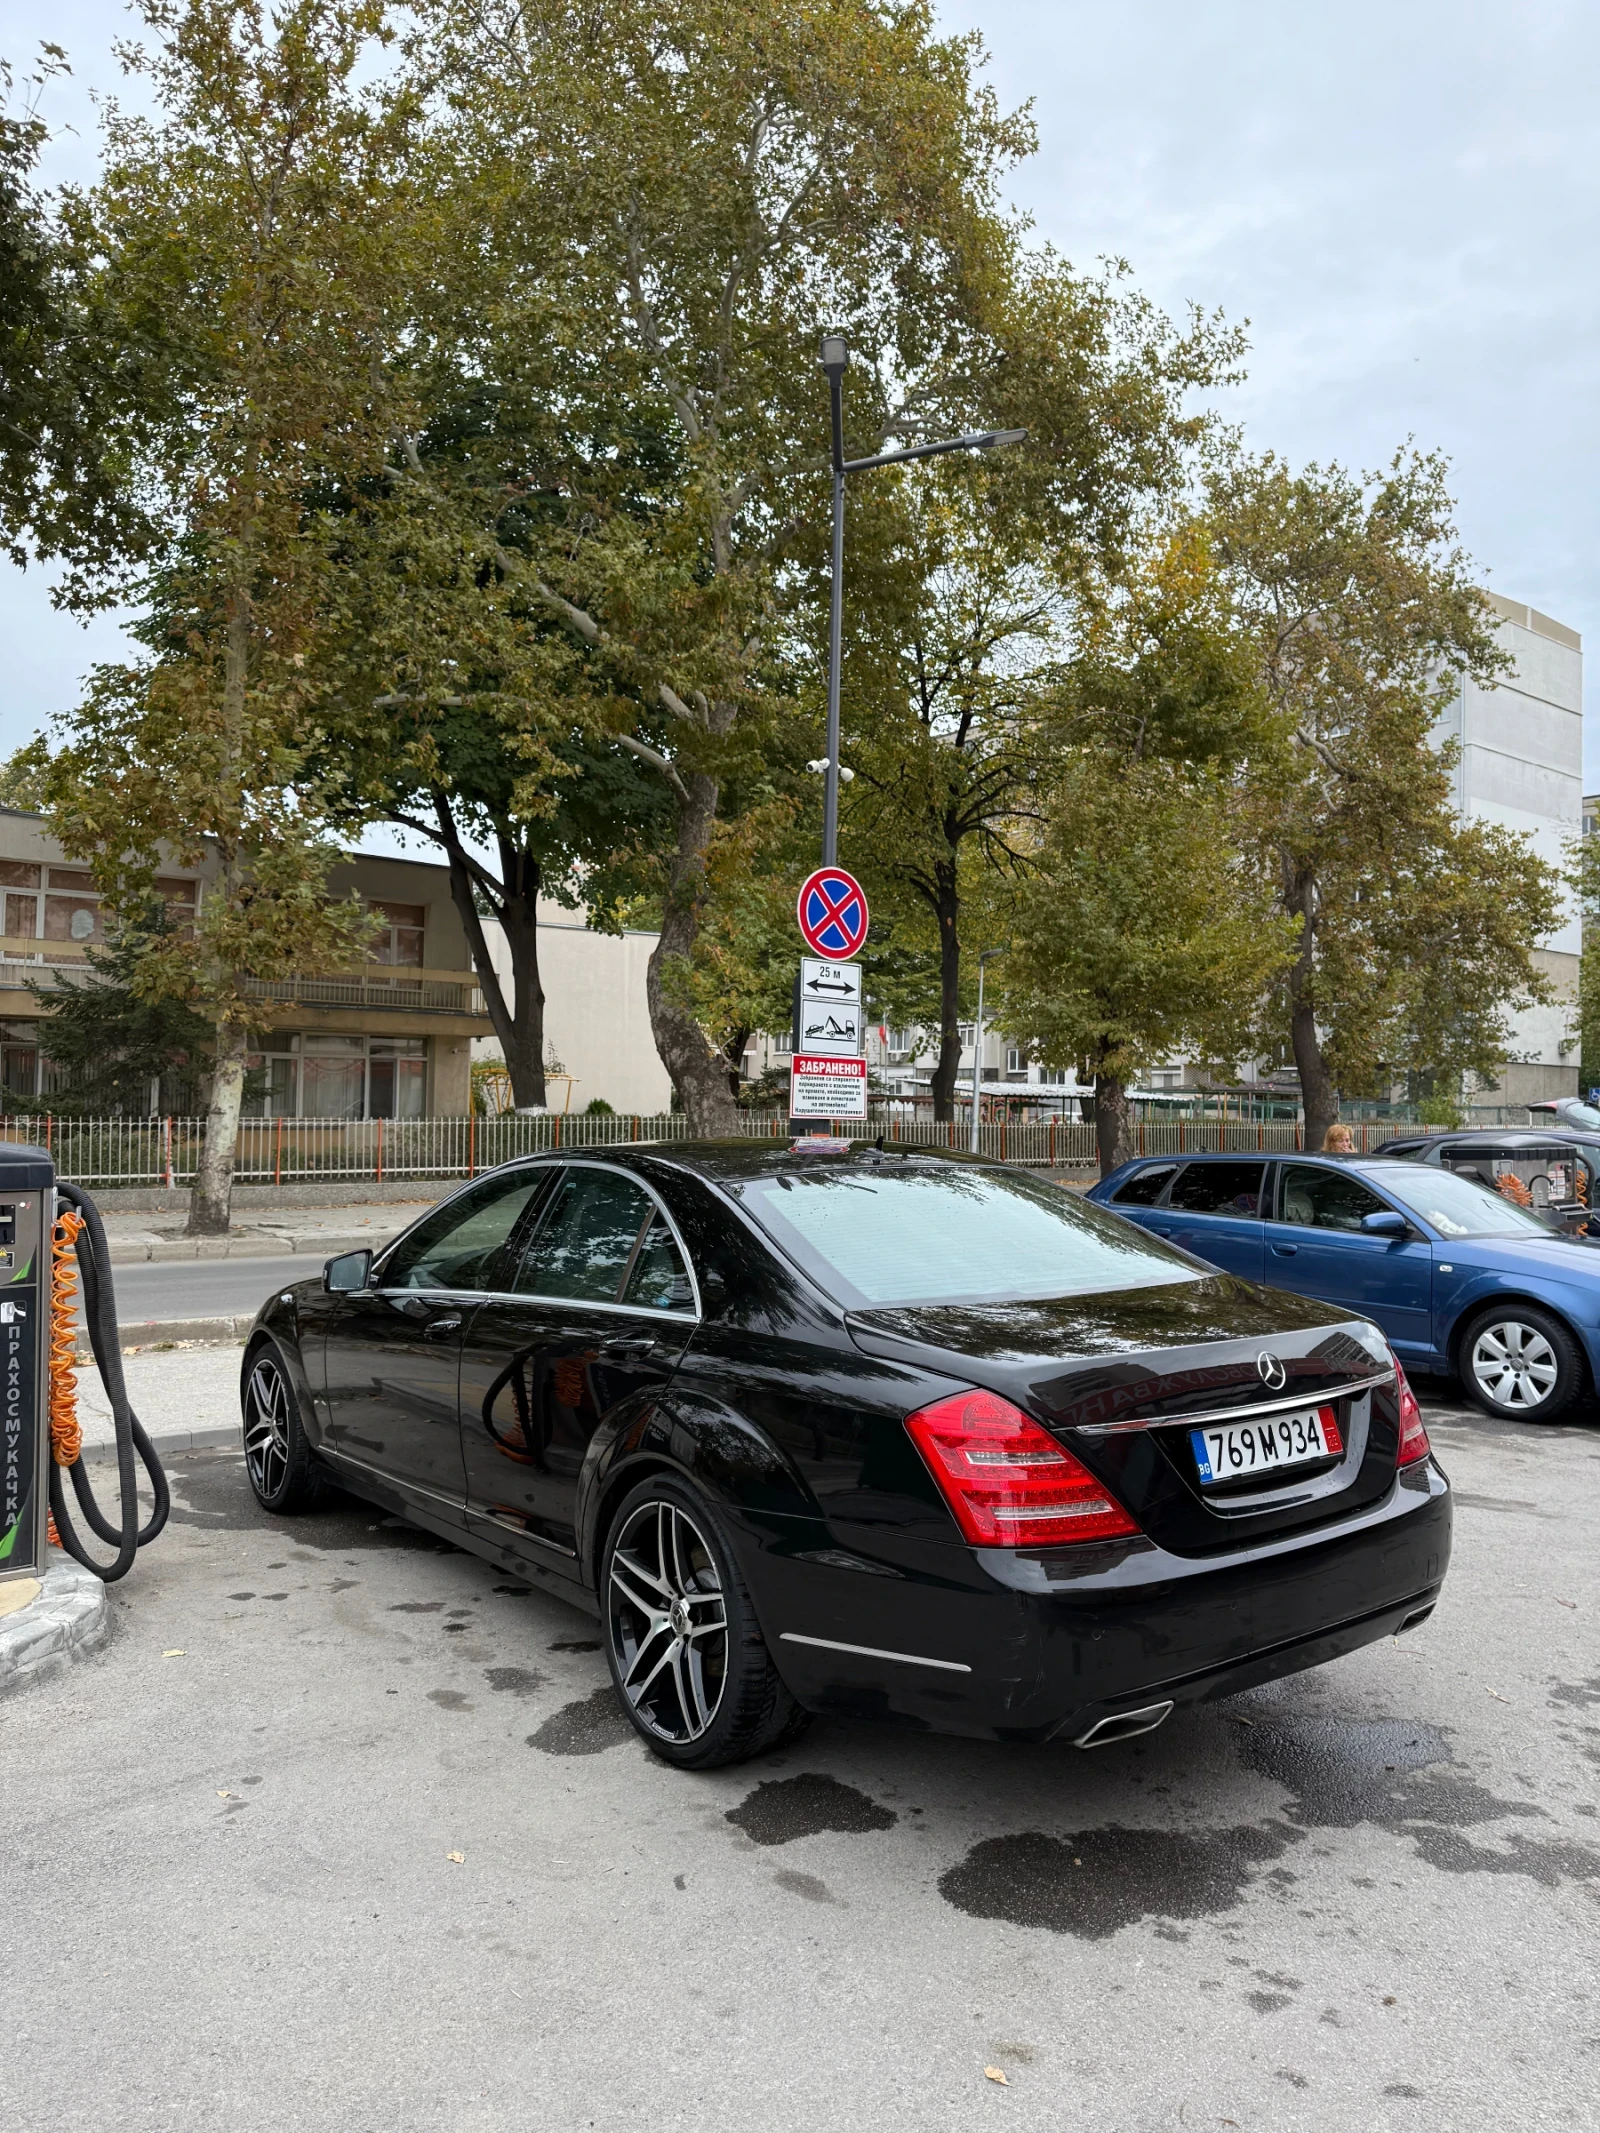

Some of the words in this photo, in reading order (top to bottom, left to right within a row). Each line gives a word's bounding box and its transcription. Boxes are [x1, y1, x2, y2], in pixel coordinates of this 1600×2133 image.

[819, 966, 830, 977] 25
[799, 1060, 862, 1075] ЗАБРАНЕНО!
[5, 1325, 21, 1526] ПРАХОСМУКАЧКА
[1208, 1416, 1321, 1473] 769M934
[1198, 1463, 1211, 1475] BG
